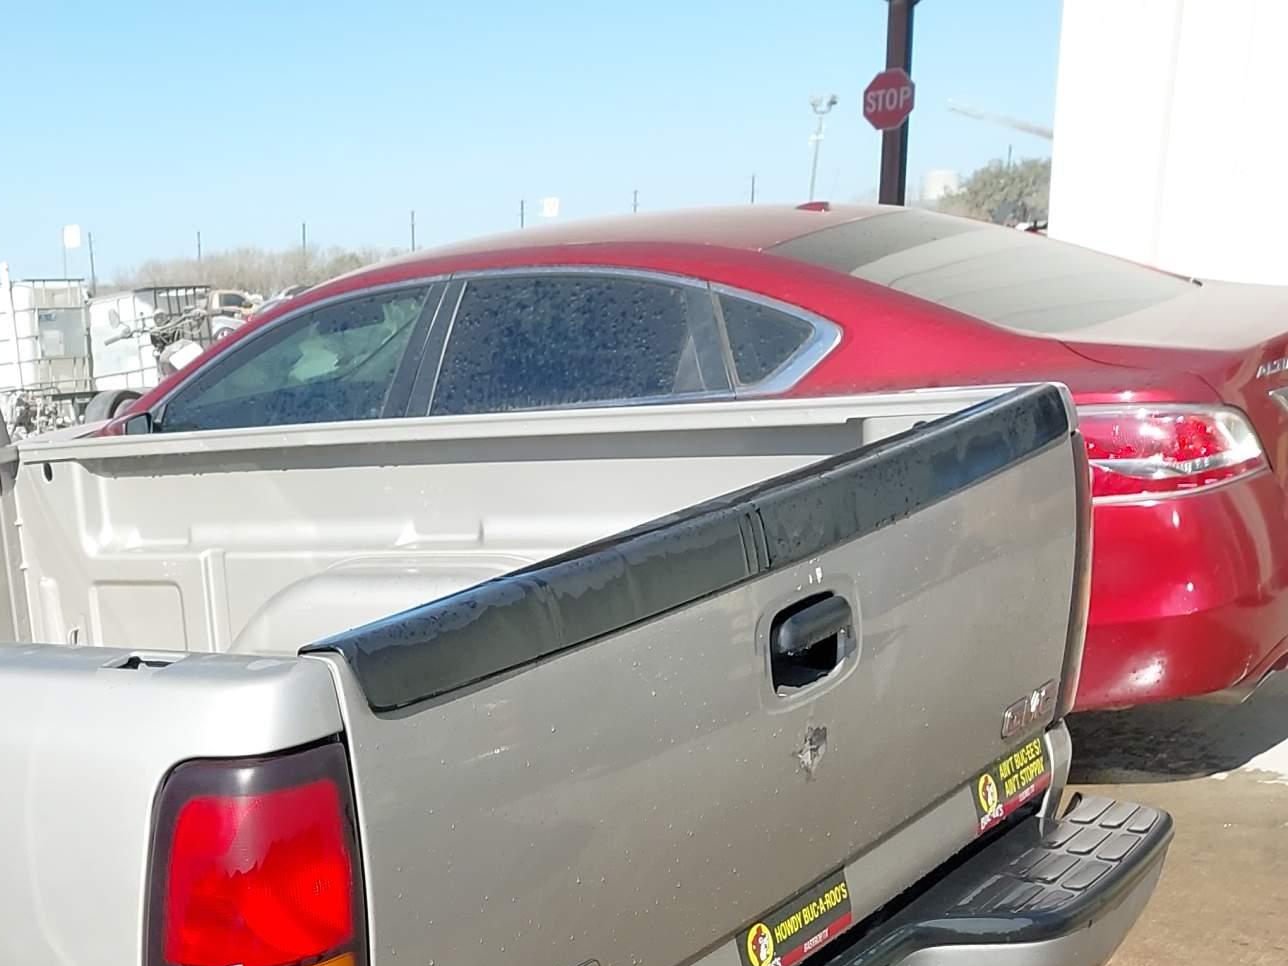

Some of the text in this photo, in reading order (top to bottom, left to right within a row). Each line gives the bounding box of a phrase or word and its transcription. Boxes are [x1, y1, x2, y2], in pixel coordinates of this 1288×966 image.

[865, 86, 912, 112] STOP
[774, 882, 848, 944] HOWDY BUC-A-ROO'S
